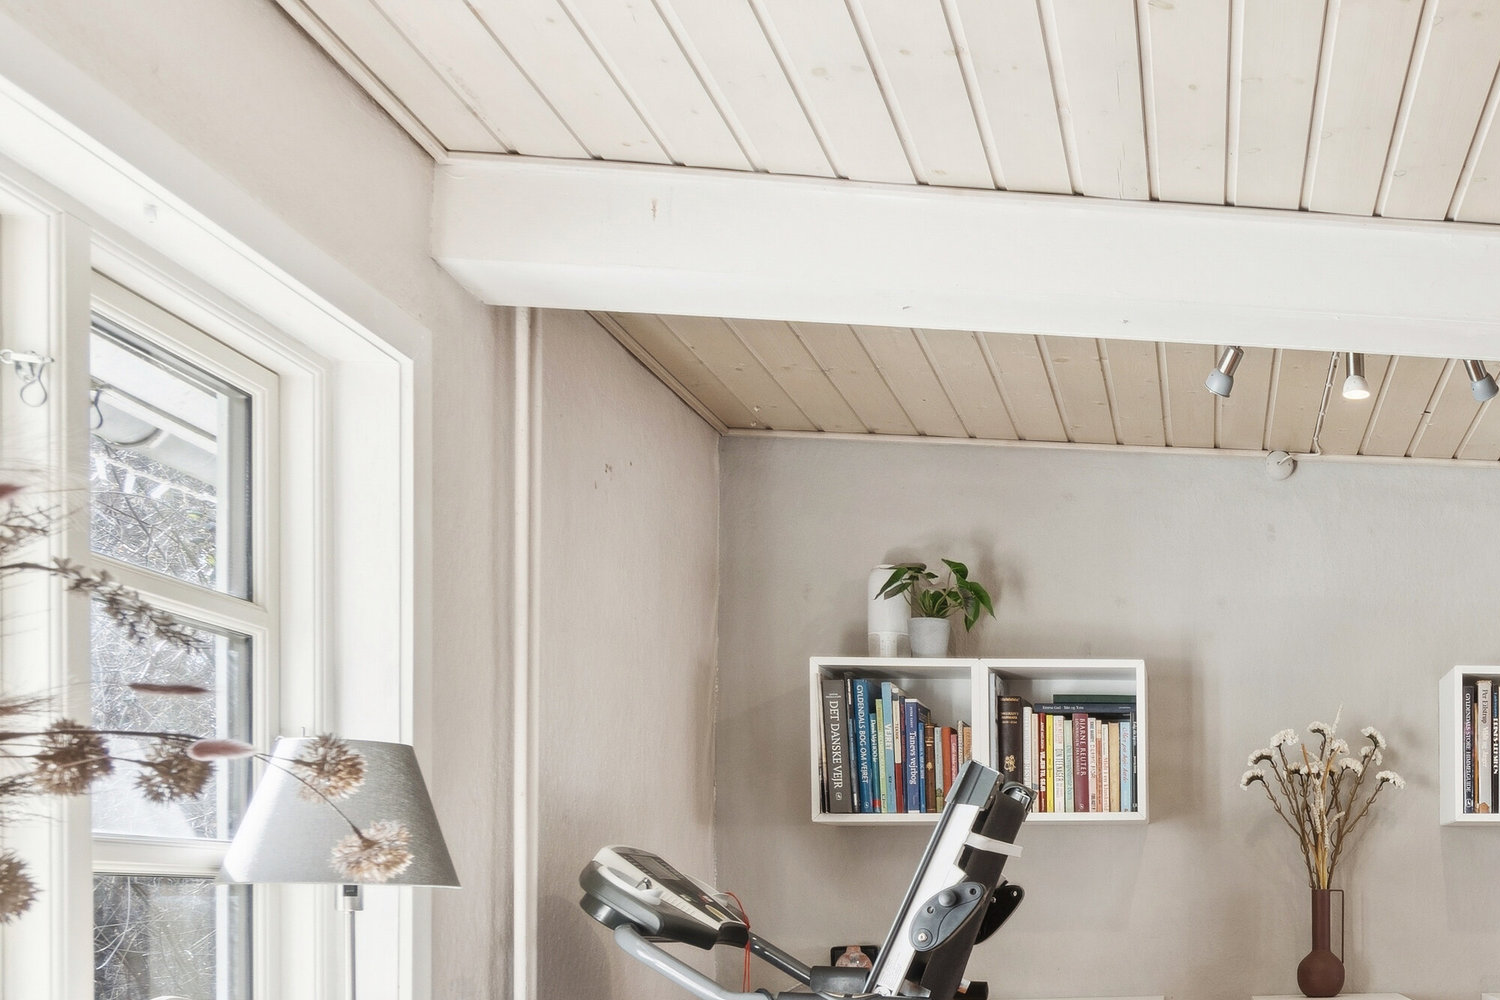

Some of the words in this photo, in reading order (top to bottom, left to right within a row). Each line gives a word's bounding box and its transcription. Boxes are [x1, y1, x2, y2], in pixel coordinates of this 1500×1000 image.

[829, 701, 840, 721] DET
[857, 685, 867, 729] GYLDENDALS
[831, 723, 842, 764] DANSKE
[859, 730, 868, 747] BOG
[884, 723, 894, 751] VEJRET
[909, 731, 918, 756] Tanevs
[1079, 718, 1087, 745] BJARNE
[860, 747, 868, 761] OM
[1080, 747, 1088, 777] REUTER
[832, 765, 843, 789] VEJR
[860, 761, 869, 784] VEJRET
[908, 757, 918, 785] vejrbog
